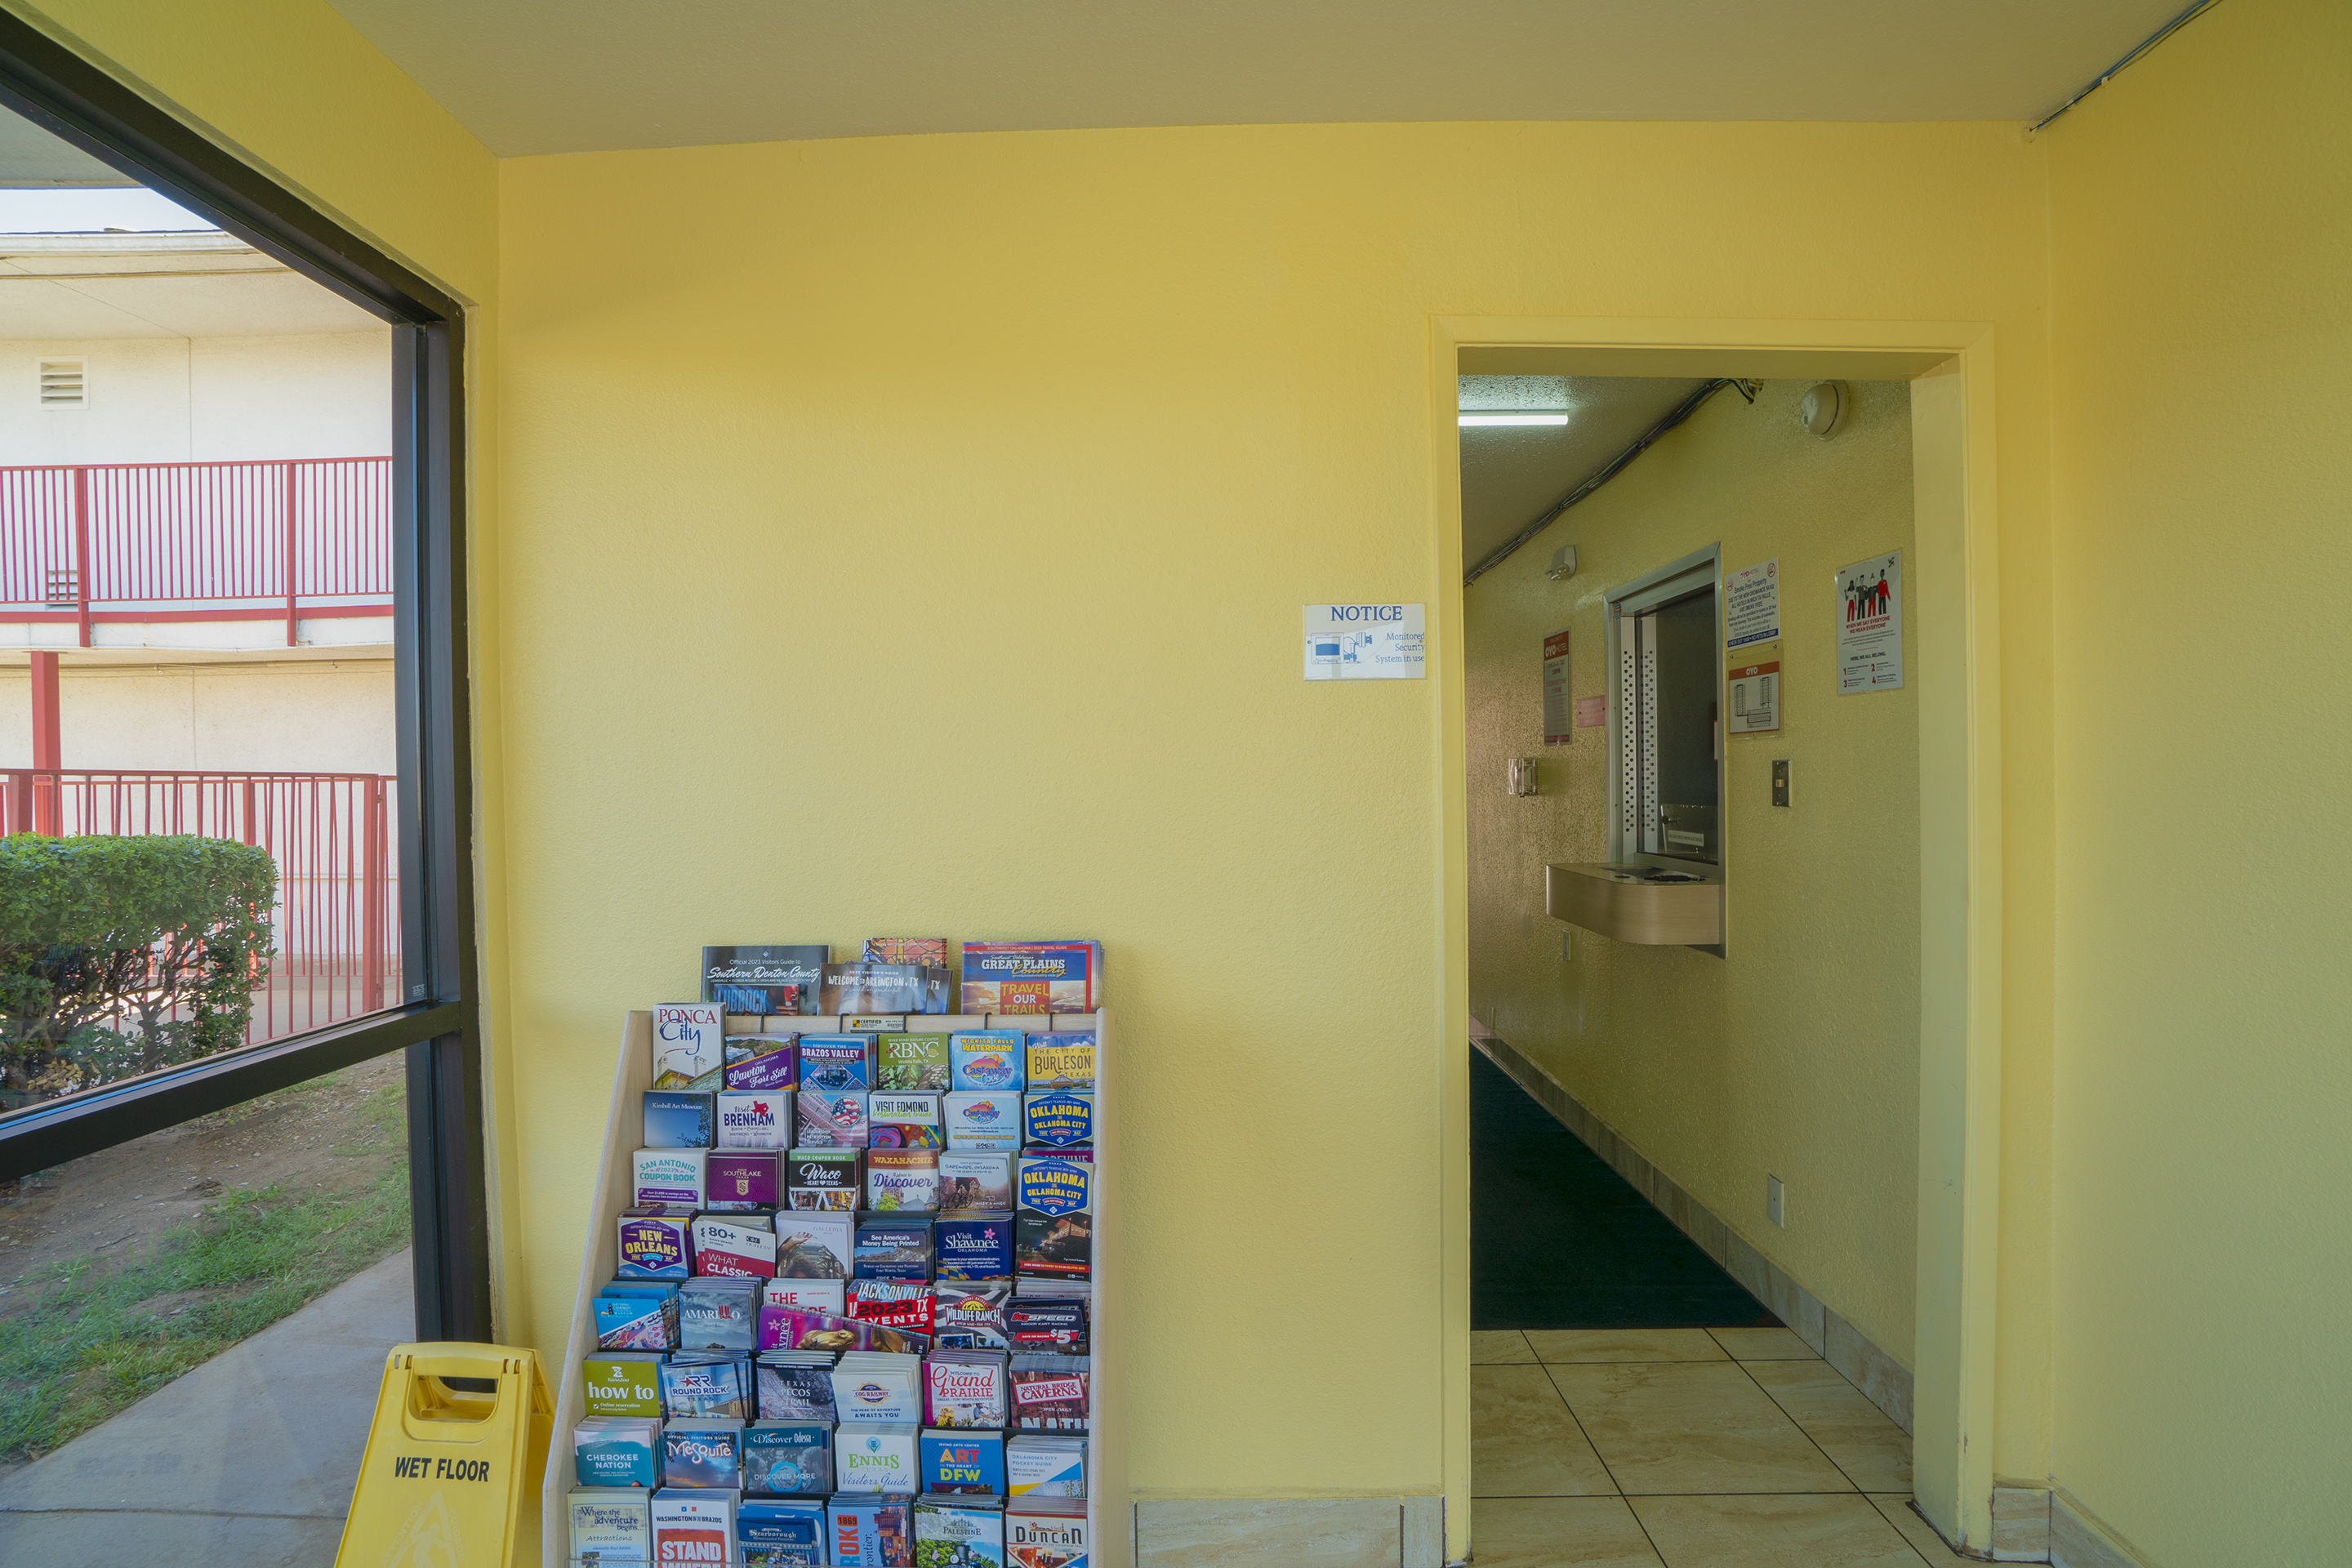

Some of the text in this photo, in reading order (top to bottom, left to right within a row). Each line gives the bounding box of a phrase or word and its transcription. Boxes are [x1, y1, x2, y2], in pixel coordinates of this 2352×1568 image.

[1330, 605, 1403, 621] NOTICE
[1866, 622, 1886, 631] EVERYONE
[1870, 616, 1891, 625] EVERYONE
[1386, 632, 1425, 641] Monitored
[1545, 643, 1568, 657] OYO HOTEL
[1375, 655, 1402, 664] System
[1746, 666, 1758, 676] OYO
[1843, 667, 1846, 675] 1
[1871, 663, 1876, 672] 2
[1843, 679, 1848, 688] 3
[1872, 676, 1877, 684] 4
[982, 959, 1066, 970] GREAT PLAINS
[1011, 964, 1067, 978] Country
[1000, 983, 1050, 997] TRAVEL
[1013, 994, 1036, 1004] OUR
[1004, 1004, 1046, 1015] TRAILS
[658, 1009, 717, 1024] PONCA
[659, 1018, 701, 1056] City
[801, 1048, 860, 1058] BRAZOS VALLEY
[962, 1064, 1013, 1078] Castaway
[1035, 1055, 1091, 1075] BURLESON
[728, 1065, 766, 1086] Lawton
[875, 1101, 929, 1111] VISIT EDMOND
[1030, 1105, 1089, 1119] OKLAHOMA
[724, 1112, 775, 1126] BRENHAM
[963, 1108, 1000, 1119] Castaway
[1034, 1120, 1087, 1129] OKLAHOMA CITY
[639, 1159, 697, 1173] SAN ANTONIO
[873, 1156, 933, 1165] WAXAHACHIE
[639, 1173, 696, 1182] COUPON BOOK
[800, 1163, 842, 1180] Waco
[874, 1173, 933, 1187] Discover
[1024, 1171, 1085, 1189] OKLAHOMA
[1027, 1189, 1082, 1200] OKLAHOMA CITY
[639, 1229, 662, 1241] NEW
[708, 1227, 737, 1240] 80+
[946, 1235, 999, 1248] Shawnee
[625, 1242, 678, 1256] ORLEANS
[708, 1253, 738, 1266] WHAT
[858, 1281, 932, 1300] JACKSONVILLE
[770, 1293, 798, 1304] THE
[858, 1298, 929, 1316] 2023 TX
[947, 1307, 1000, 1322] WILDLIFE RANCH
[931, 1365, 996, 1396] Grand
[587, 1381, 654, 1400] how to
[781, 1388, 811, 1397] PECOS
[942, 1388, 993, 1398] PRAIRIE
[1021, 1384, 1049, 1392] NATURAL
[1021, 1388, 1079, 1401] CAVERNS
[786, 1398, 812, 1406] TRAIL
[753, 1432, 812, 1444] Discover Odessa
[586, 1454, 639, 1462] CHEROKEE
[848, 1454, 899, 1469] ENNIS
[939, 1448, 980, 1463] ART
[394, 1457, 490, 1482] WET FLOOR
[595, 1461, 631, 1469] NATION
[842, 1472, 909, 1486] Visitors Guide
[940, 1468, 981, 1481] DFW
[594, 1516, 639, 1525] adventure
[838, 1517, 858, 1525] 1869
[749, 1529, 797, 1539] Scarborough
[943, 1526, 982, 1535] PALESTINE
[1015, 1526, 1083, 1544] DUNCAN
[586, 1534, 633, 1542] Attractions
[662, 1540, 722, 1561] STAND
